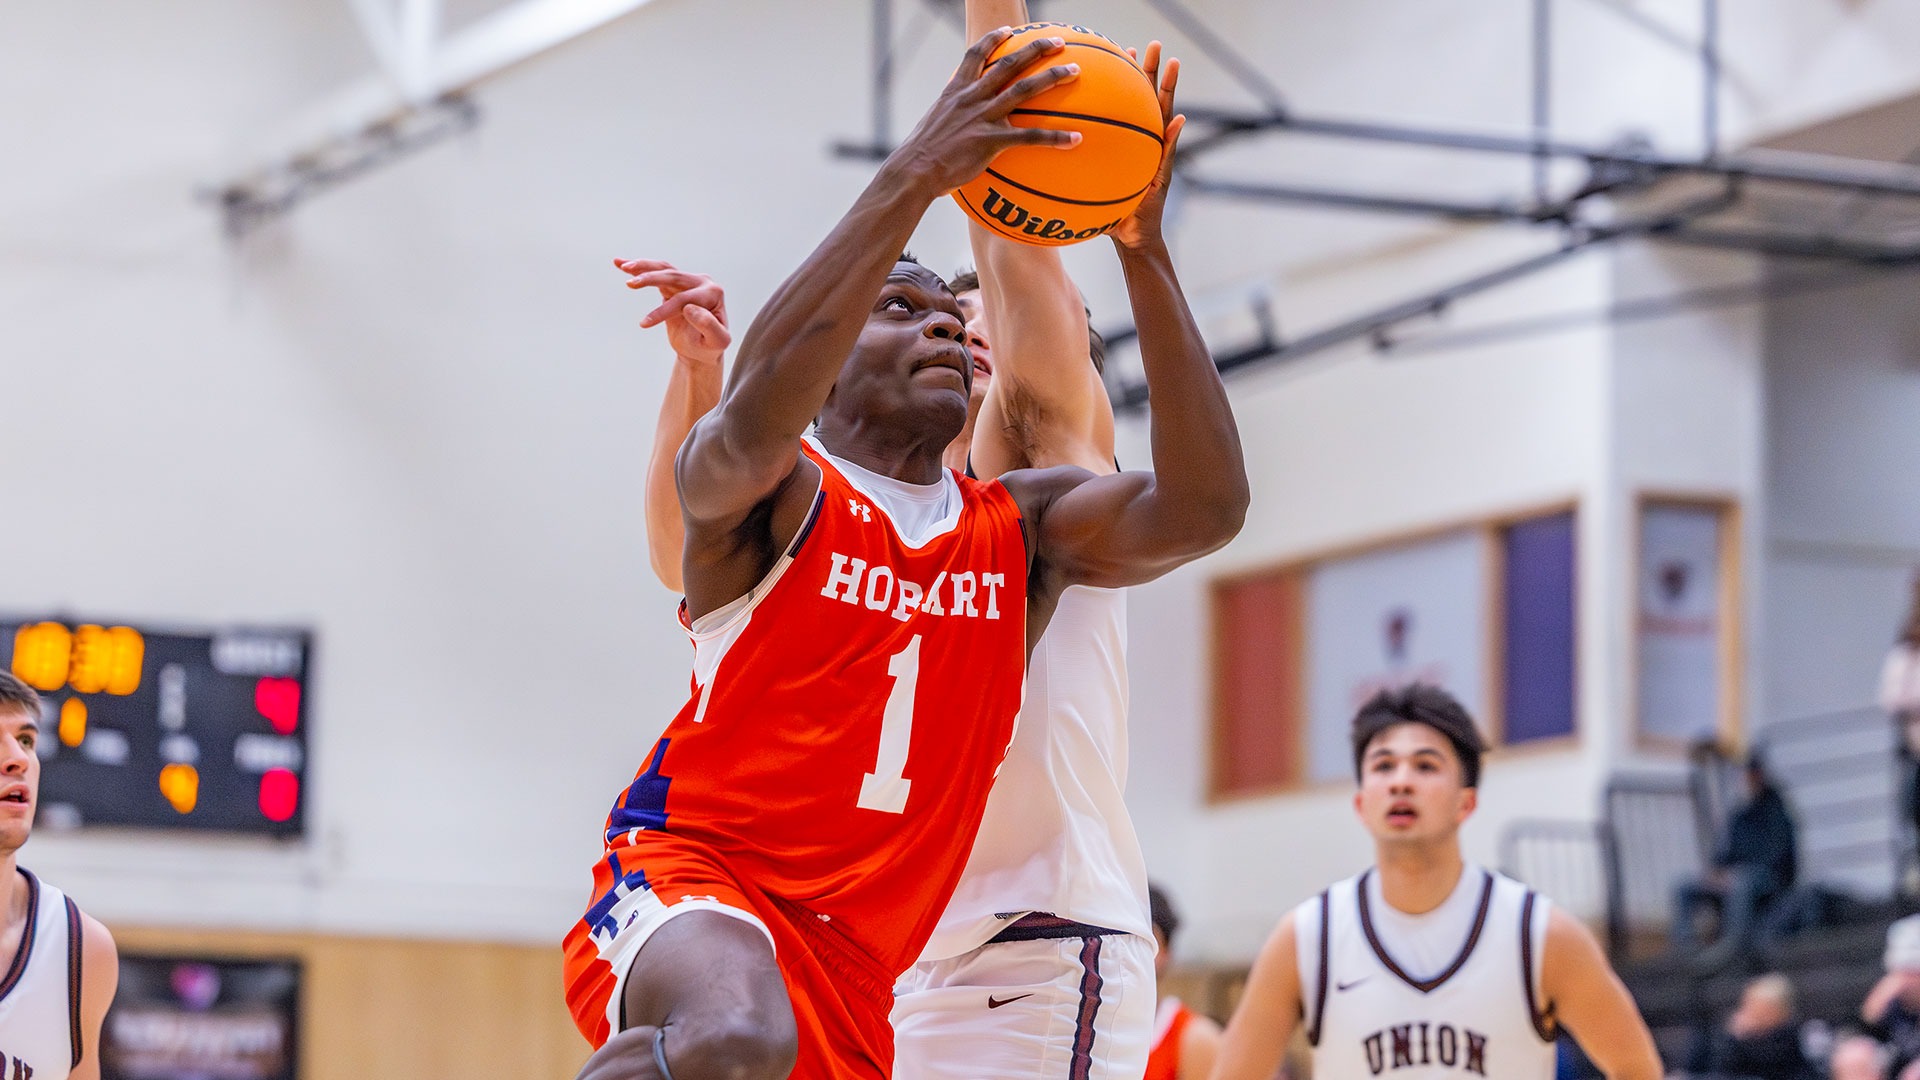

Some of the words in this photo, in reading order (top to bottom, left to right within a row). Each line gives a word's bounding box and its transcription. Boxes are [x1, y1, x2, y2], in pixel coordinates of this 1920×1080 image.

[820, 552, 1005, 622] HOBART
[856, 634, 922, 814] 1
[1362, 1022, 1487, 1077] UNION
